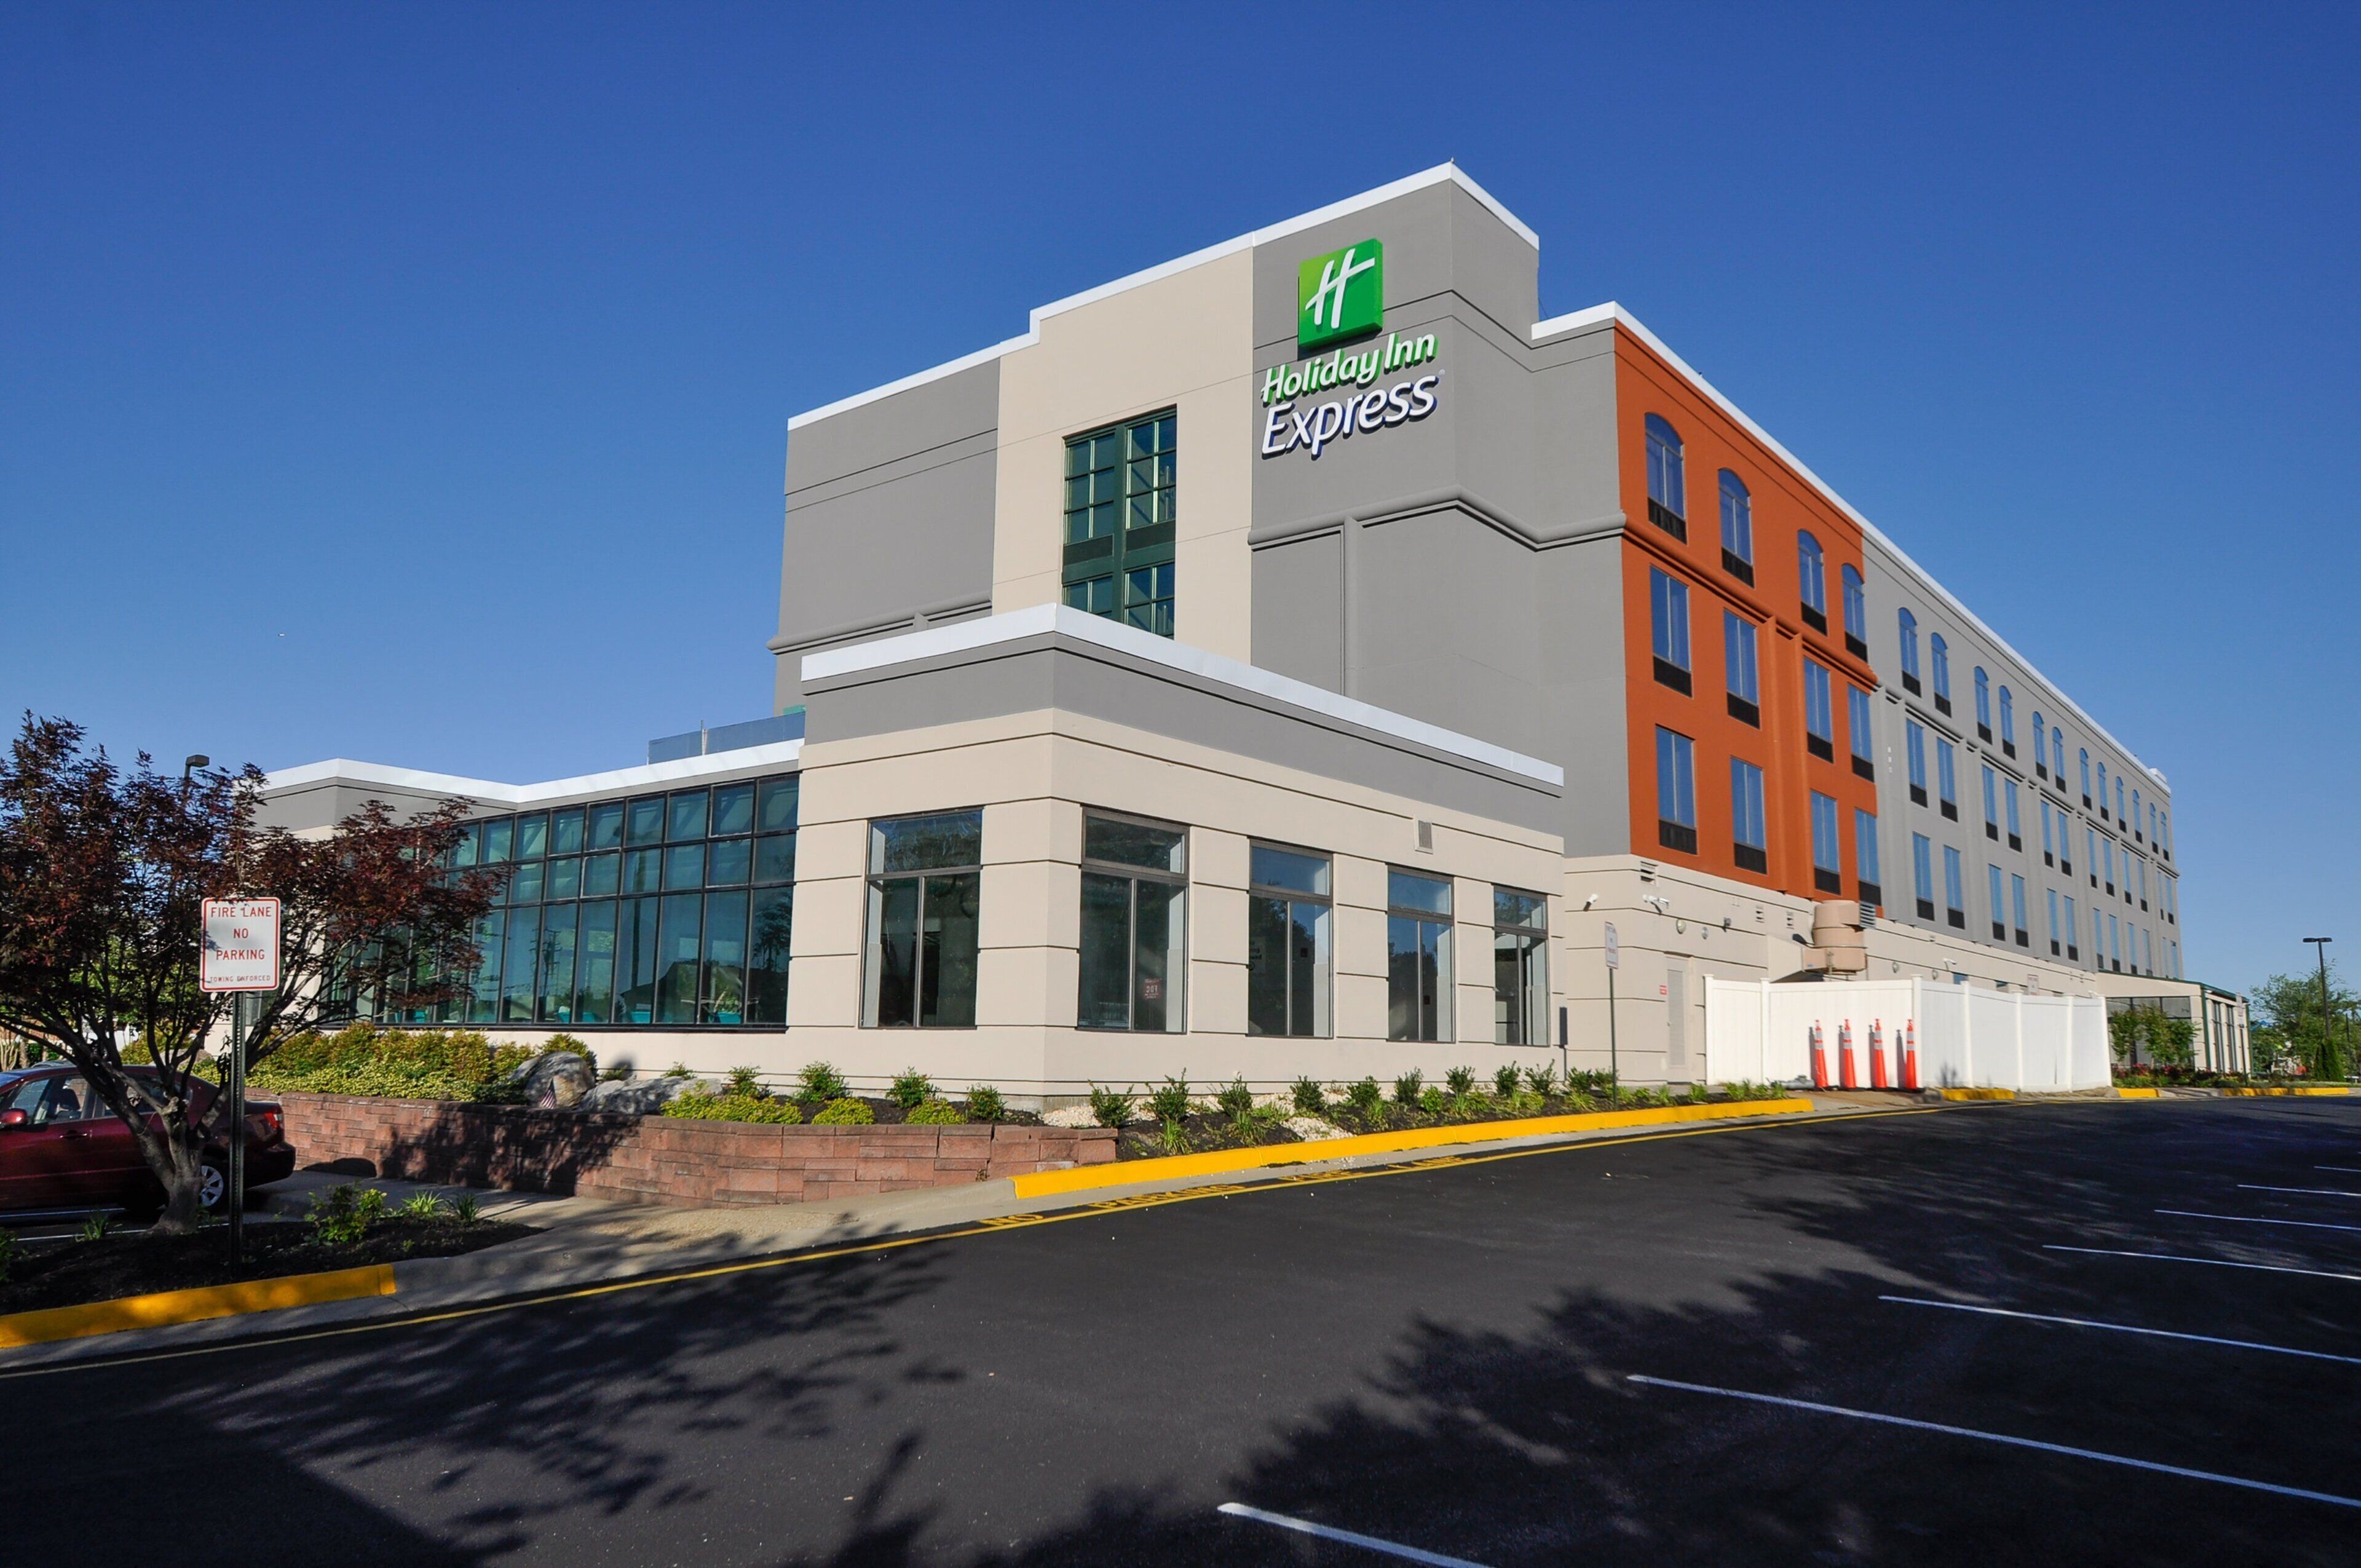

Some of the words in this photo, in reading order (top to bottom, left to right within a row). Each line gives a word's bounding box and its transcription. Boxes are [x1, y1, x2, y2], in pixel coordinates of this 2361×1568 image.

[1261, 349, 1382, 403] Holiday
[1384, 333, 1436, 370] Inn
[1262, 376, 1438, 456] Express
[211, 907, 236, 917] FIRE
[242, 906, 272, 917] LANE
[233, 928, 248, 938] NO
[216, 949, 265, 960] PARKING
